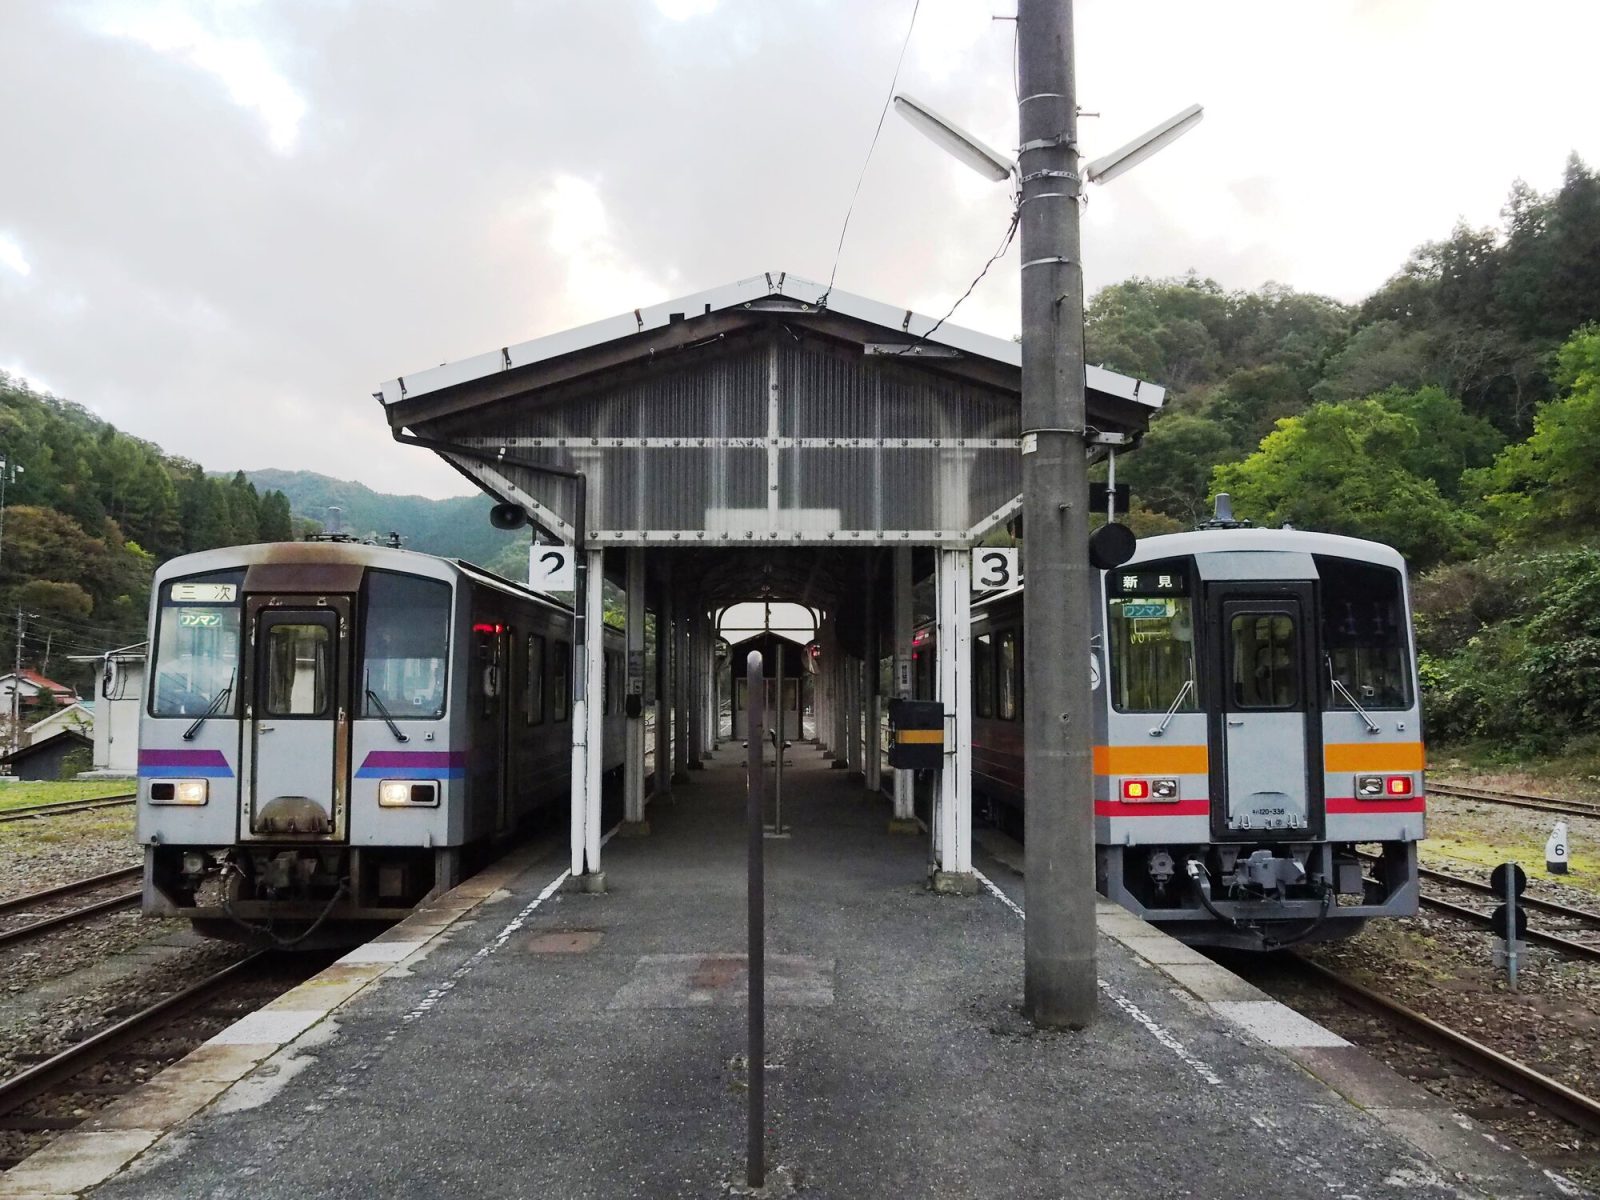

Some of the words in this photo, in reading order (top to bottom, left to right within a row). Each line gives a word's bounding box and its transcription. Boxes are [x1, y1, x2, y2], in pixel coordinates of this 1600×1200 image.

[980, 552, 1010, 587] 3
[1123, 575, 1172, 589] 新見
[180, 584, 231, 601] 三次
[1125, 605, 1165, 617] ワンマン
[181, 615, 221, 626] ワンマン
[1555, 844, 1565, 856] 6
